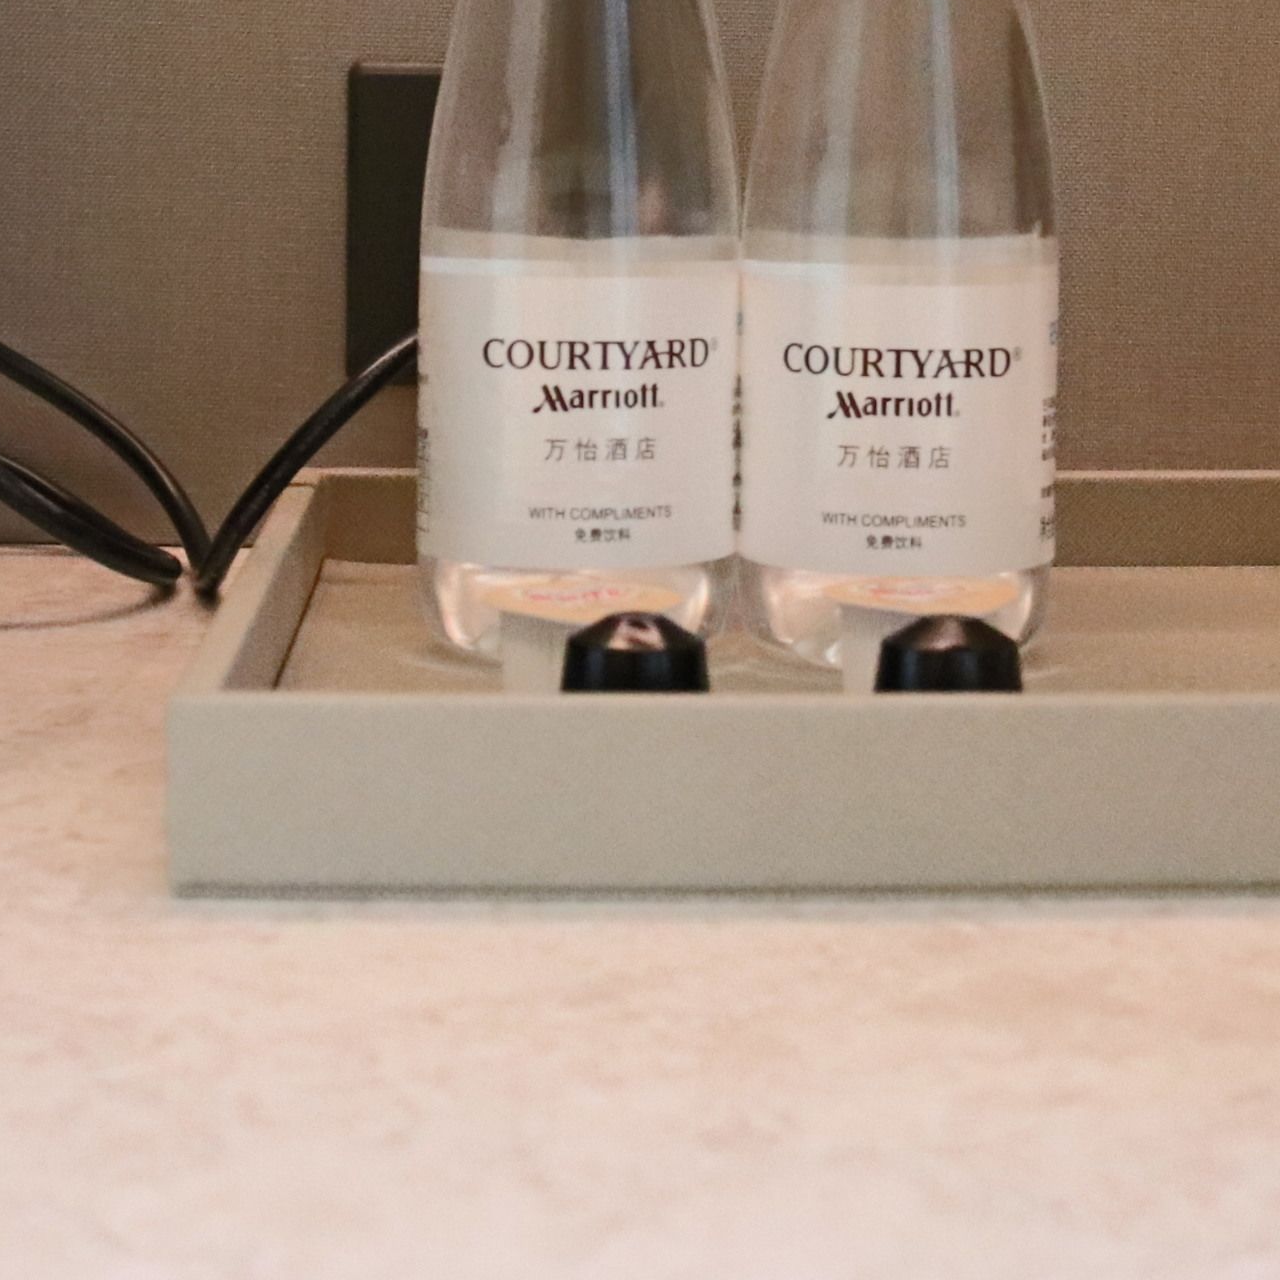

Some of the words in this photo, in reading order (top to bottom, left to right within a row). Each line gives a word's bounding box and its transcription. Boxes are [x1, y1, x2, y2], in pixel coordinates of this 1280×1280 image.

[482, 337, 710, 371] COURTYARD
[782, 342, 1012, 379] COURTYARD
[532, 383, 659, 413] Marriott
[826, 390, 954, 420] Marriott
[544, 437, 657, 462] 万怡酒店
[837, 445, 952, 469] 万怡酒店
[528, 506, 566, 521] WITH
[569, 504, 673, 521] COMPLIMENTS
[821, 511, 858, 527] WITH
[861, 513, 967, 529] COMPLIMENTS
